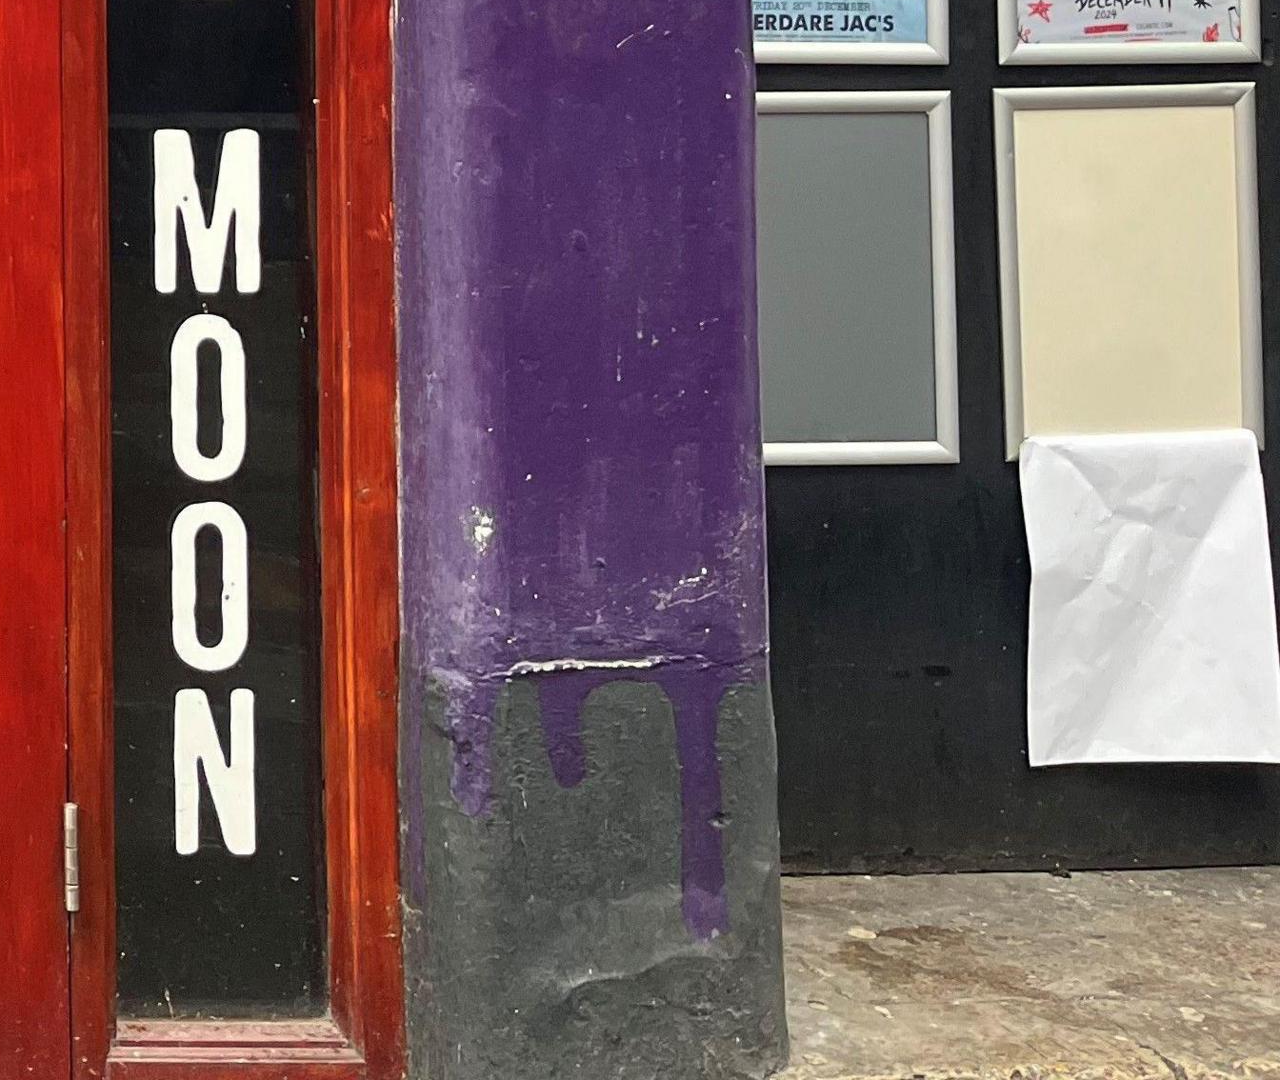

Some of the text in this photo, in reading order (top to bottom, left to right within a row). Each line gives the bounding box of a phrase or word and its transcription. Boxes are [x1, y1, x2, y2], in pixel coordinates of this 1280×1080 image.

[817, 1, 871, 12] DECEMBER
[1095, 9, 1117, 20] 2024
[754, 14, 894, 32] ERDARE JAC'S
[153, 128, 261, 856] MOON
